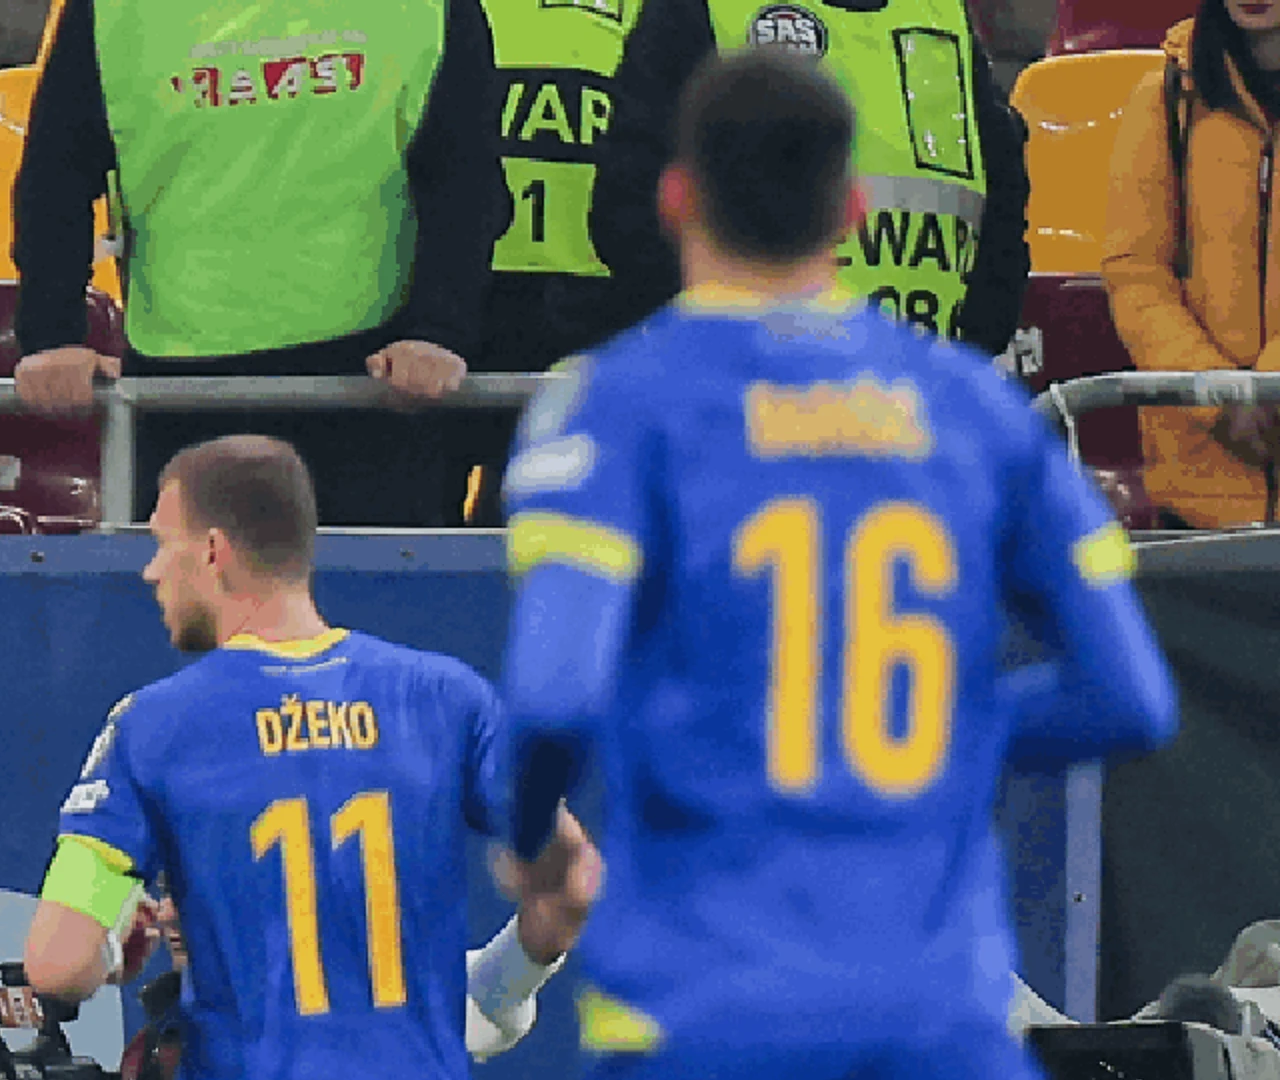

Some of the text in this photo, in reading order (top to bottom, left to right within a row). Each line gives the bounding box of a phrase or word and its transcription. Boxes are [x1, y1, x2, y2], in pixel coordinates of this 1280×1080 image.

[256, 693, 379, 757] DŽEKO
[736, 498, 955, 794] 16
[250, 791, 407, 1016] 11
